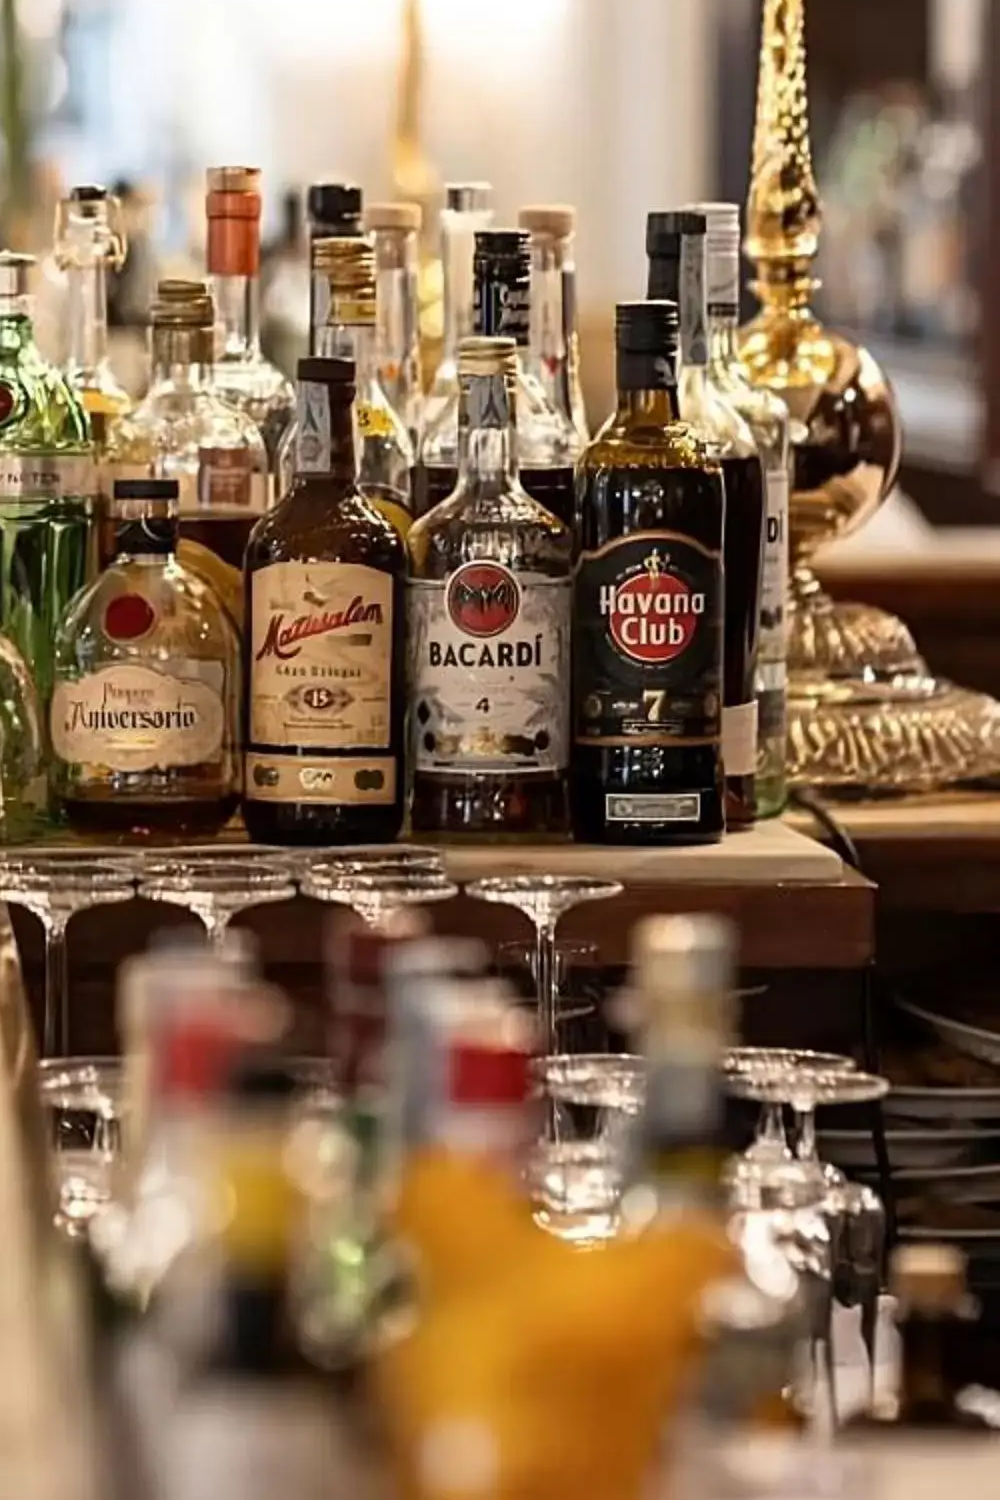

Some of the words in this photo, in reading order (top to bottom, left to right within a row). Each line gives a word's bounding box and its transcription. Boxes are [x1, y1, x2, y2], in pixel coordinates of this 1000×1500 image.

[600, 584, 706, 616] Havana
[256, 596, 383, 661] Matusalem
[620, 617, 685, 645] Club
[429, 633, 543, 667] BACARDÍ
[312, 689, 329, 707] 15
[475, 697, 490, 714] 4
[642, 690, 665, 721] 7
